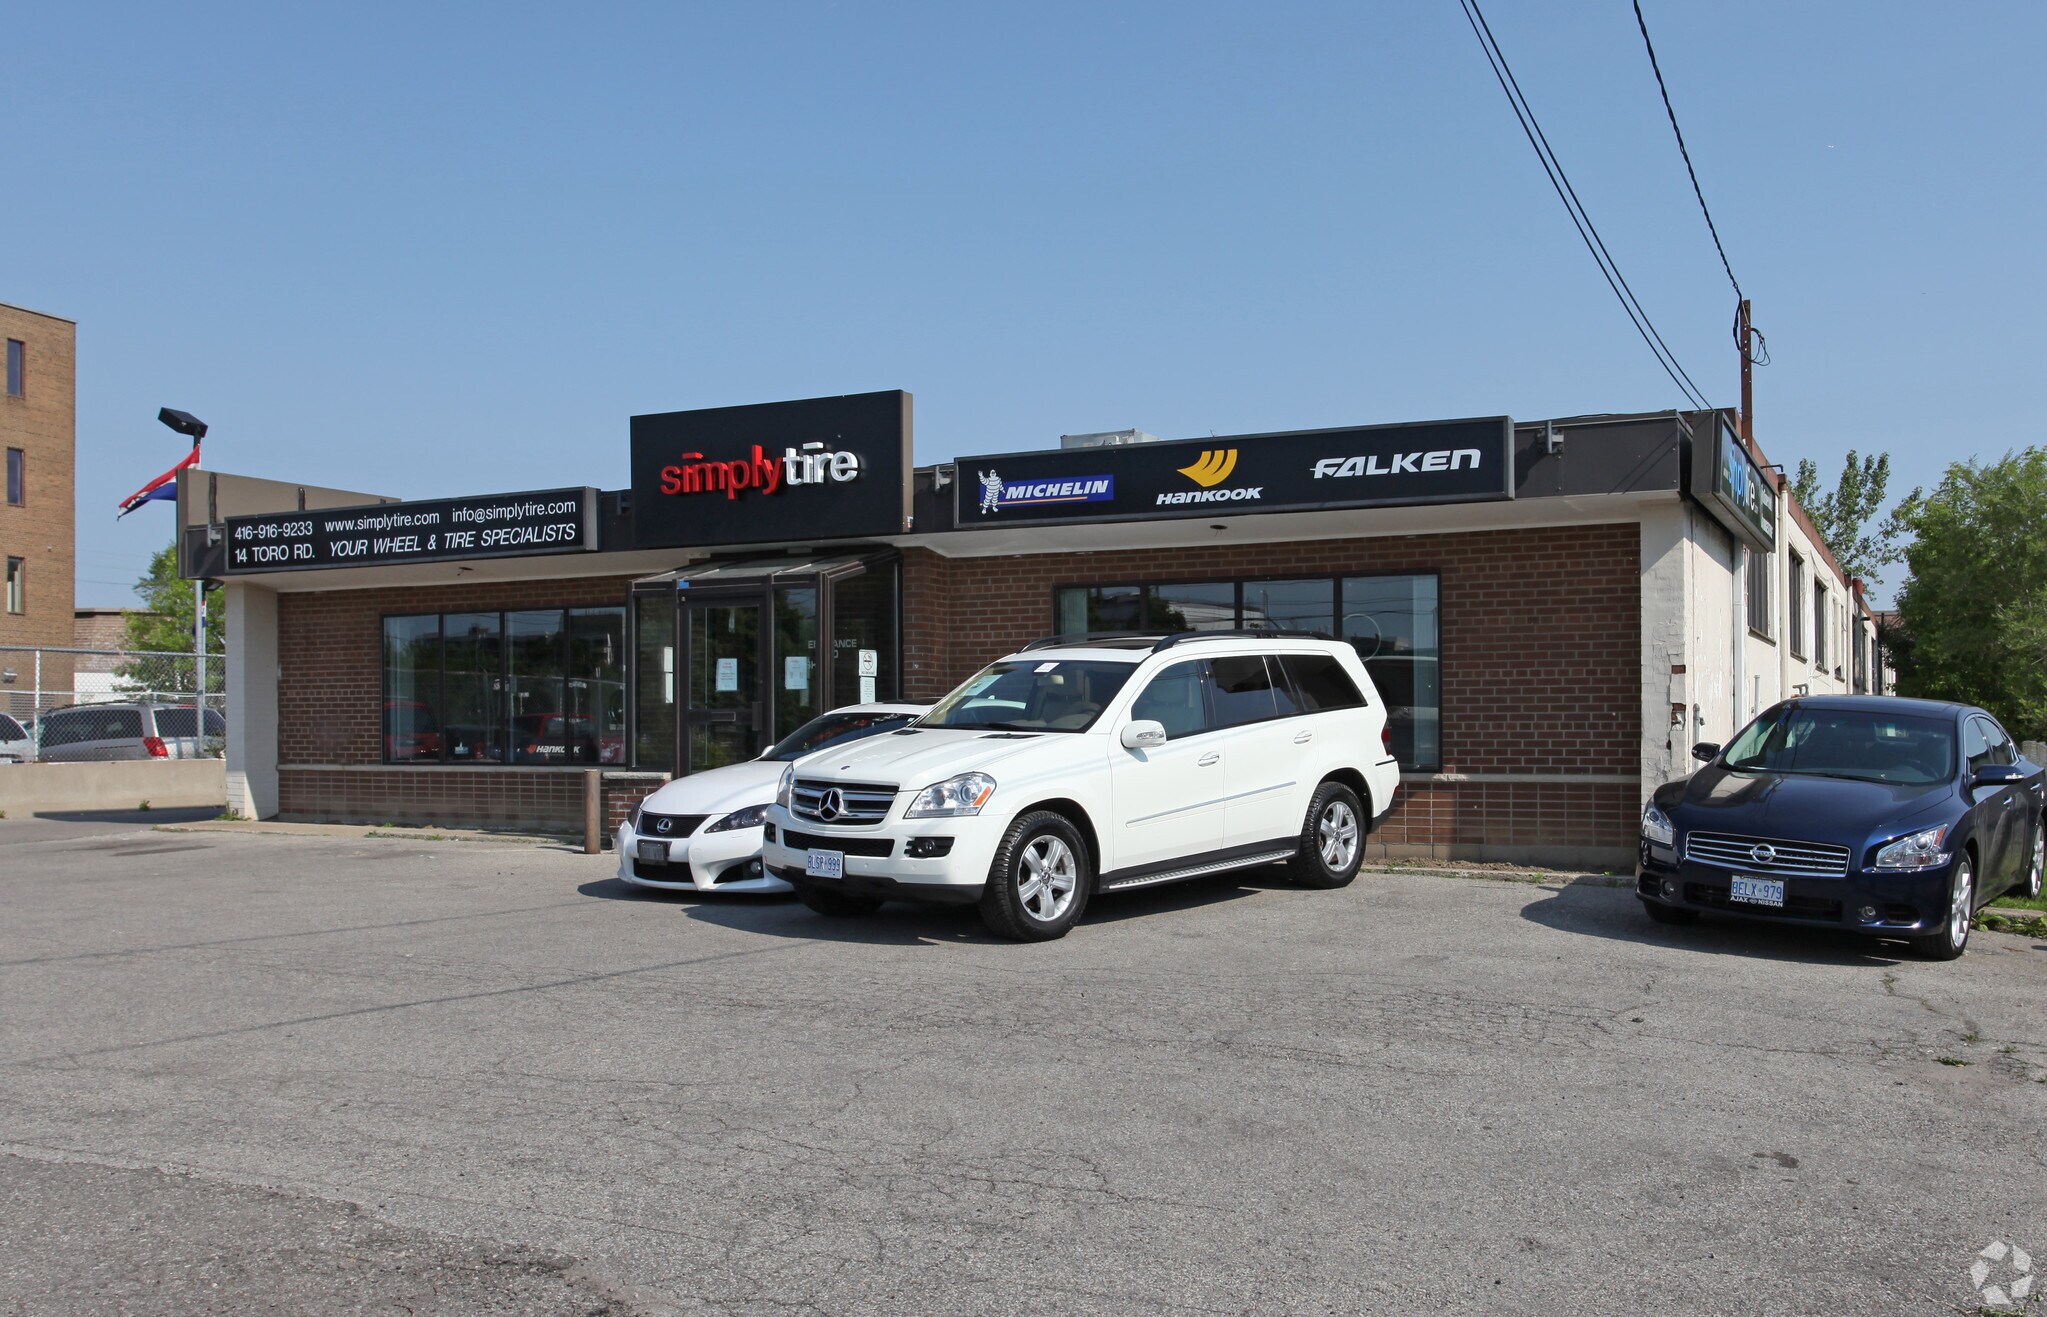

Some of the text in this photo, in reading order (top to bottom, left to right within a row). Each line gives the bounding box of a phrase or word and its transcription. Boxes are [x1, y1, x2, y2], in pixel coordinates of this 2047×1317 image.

[660, 441, 858, 500] simplytire
[1310, 448, 1481, 479] FALKEN
[1005, 479, 1109, 499] MICHELIN
[235, 501, 576, 540] 416-916-9233 www.simplytire.com info@simplytire.com
[330, 523, 576, 557] YOUR WHEEL & TIRE SPECIALISTS
[235, 543, 315, 563] 14 TORO RD.
[1758, 899, 1783, 907] NISSAN
[1763, 884, 1782, 900] 979
